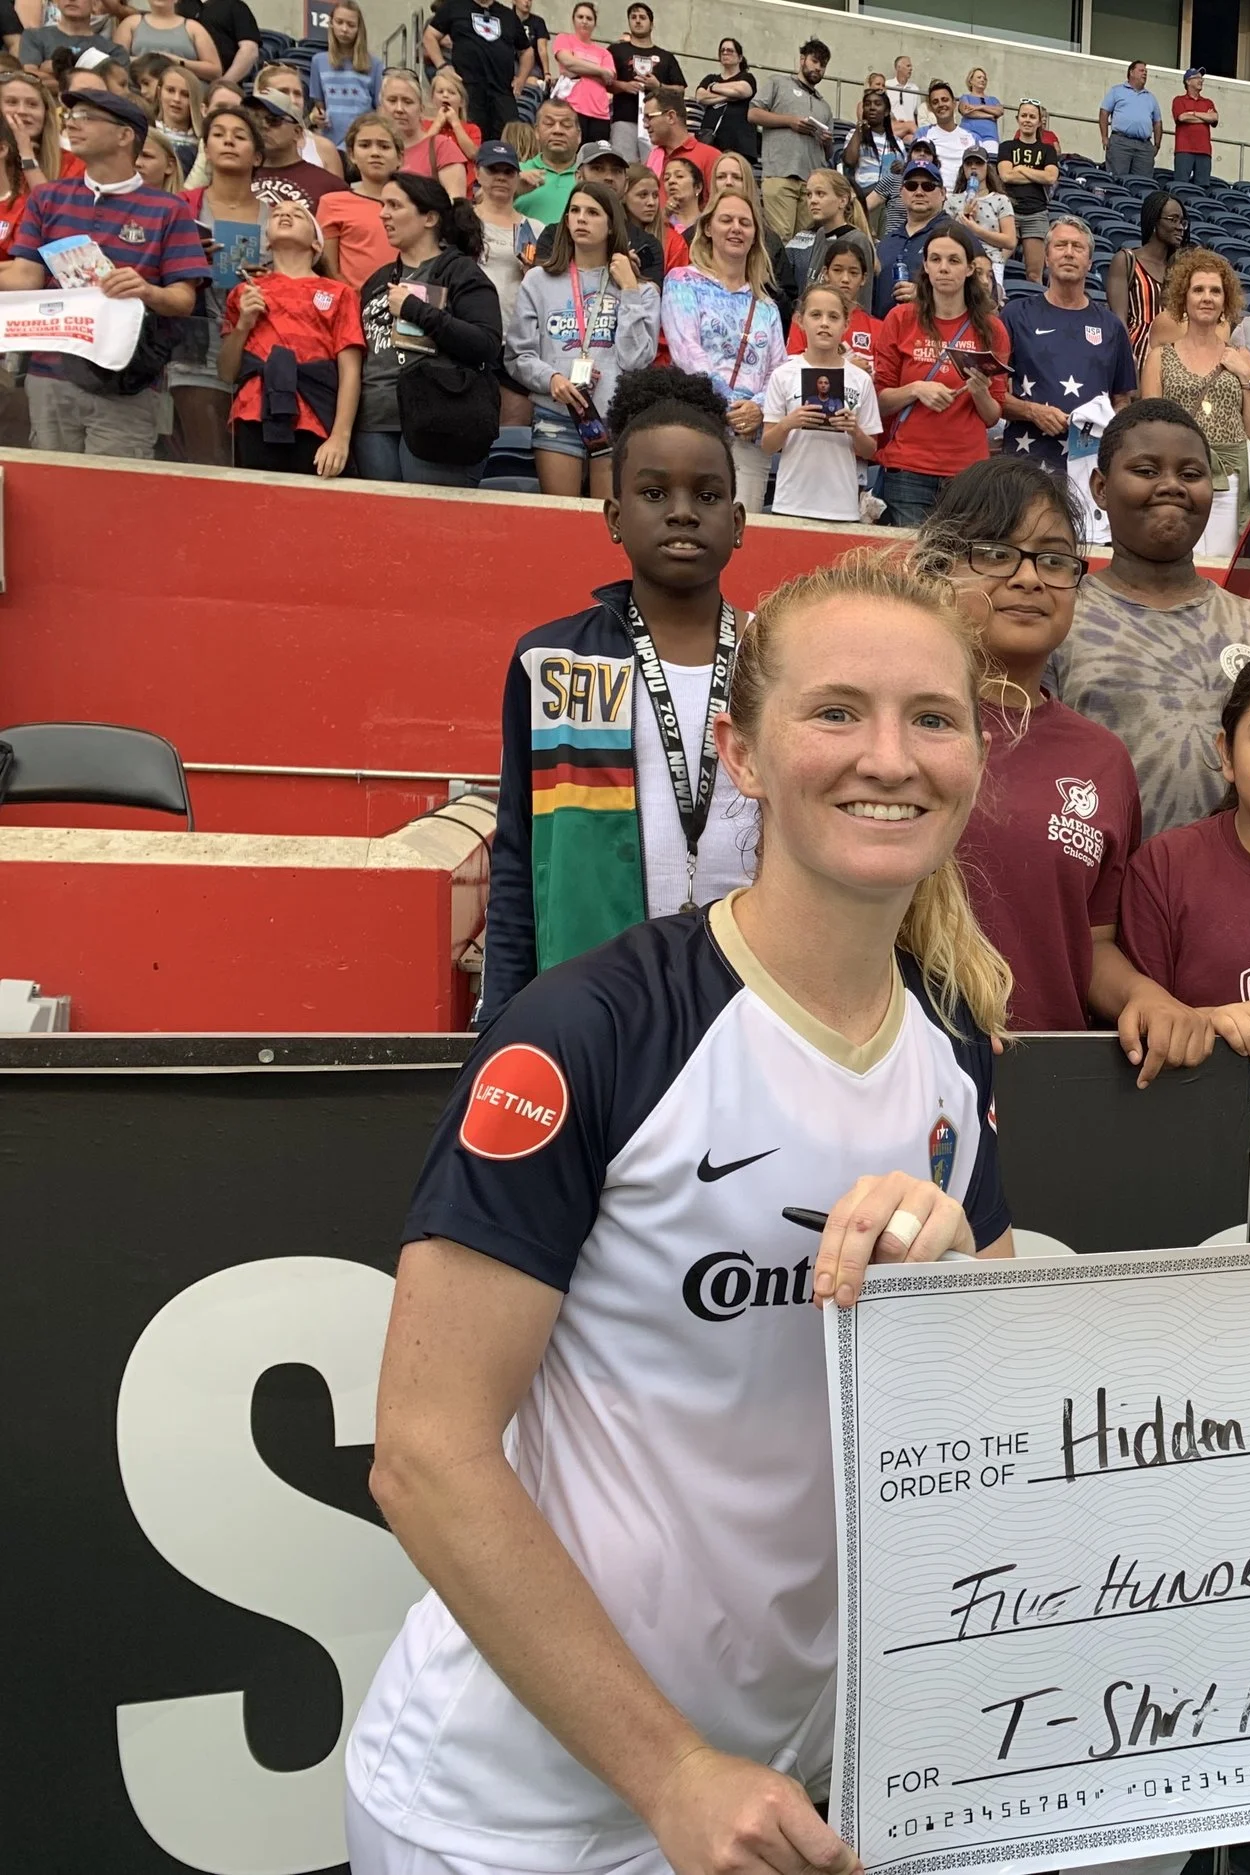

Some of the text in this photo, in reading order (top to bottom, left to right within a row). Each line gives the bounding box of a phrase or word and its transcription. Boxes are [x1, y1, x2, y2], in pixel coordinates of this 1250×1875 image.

[311, 11, 330, 28] 12
[1012, 148, 1042, 165] USA
[6, 316, 95, 327] WORLD CUP
[64, 325, 94, 335] BACK
[633, 634, 668, 693] NPWU
[712, 655, 728, 690] 707
[659, 701, 680, 740] 707
[667, 751, 693, 815] NPWU
[1063, 845, 1095, 868] Chicago
[475, 1080, 558, 1129] LIFETIME
[682, 1248, 816, 1324] Cont
[879, 1469, 971, 1503] ORDER
[980, 1464, 1016, 1488] OF
[1060, 1386, 1246, 1484] Hidden
[879, 1432, 1030, 1473] PAY TO THE
[886, 1765, 941, 1799] FOR
